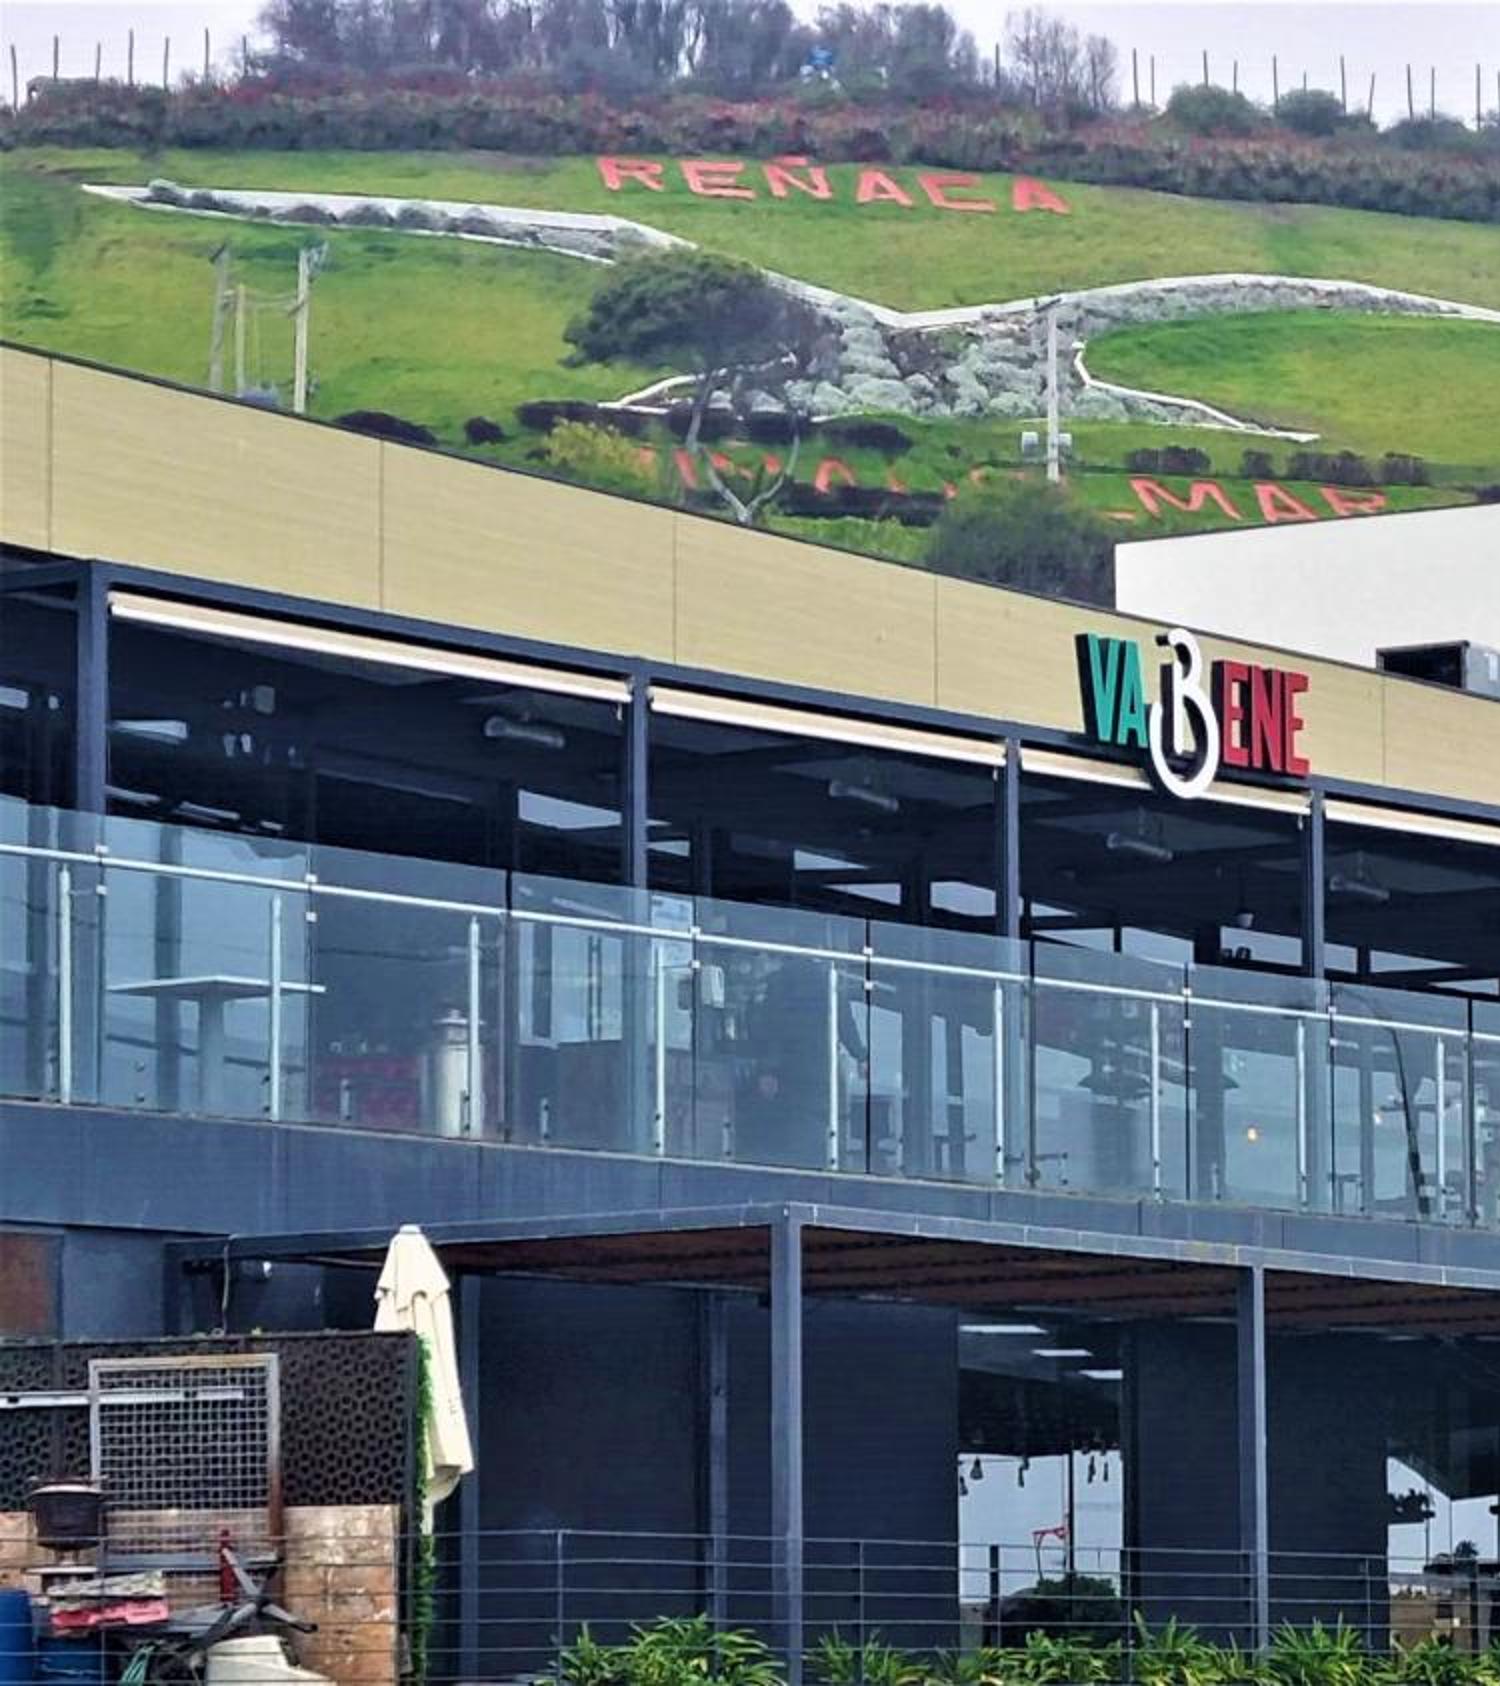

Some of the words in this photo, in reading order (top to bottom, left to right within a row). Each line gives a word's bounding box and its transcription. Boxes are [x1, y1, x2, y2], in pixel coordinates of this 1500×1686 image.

[598, 154, 1072, 216] REÑACA
[1074, 632, 1149, 748] VA
[1150, 627, 1311, 799] BENE
